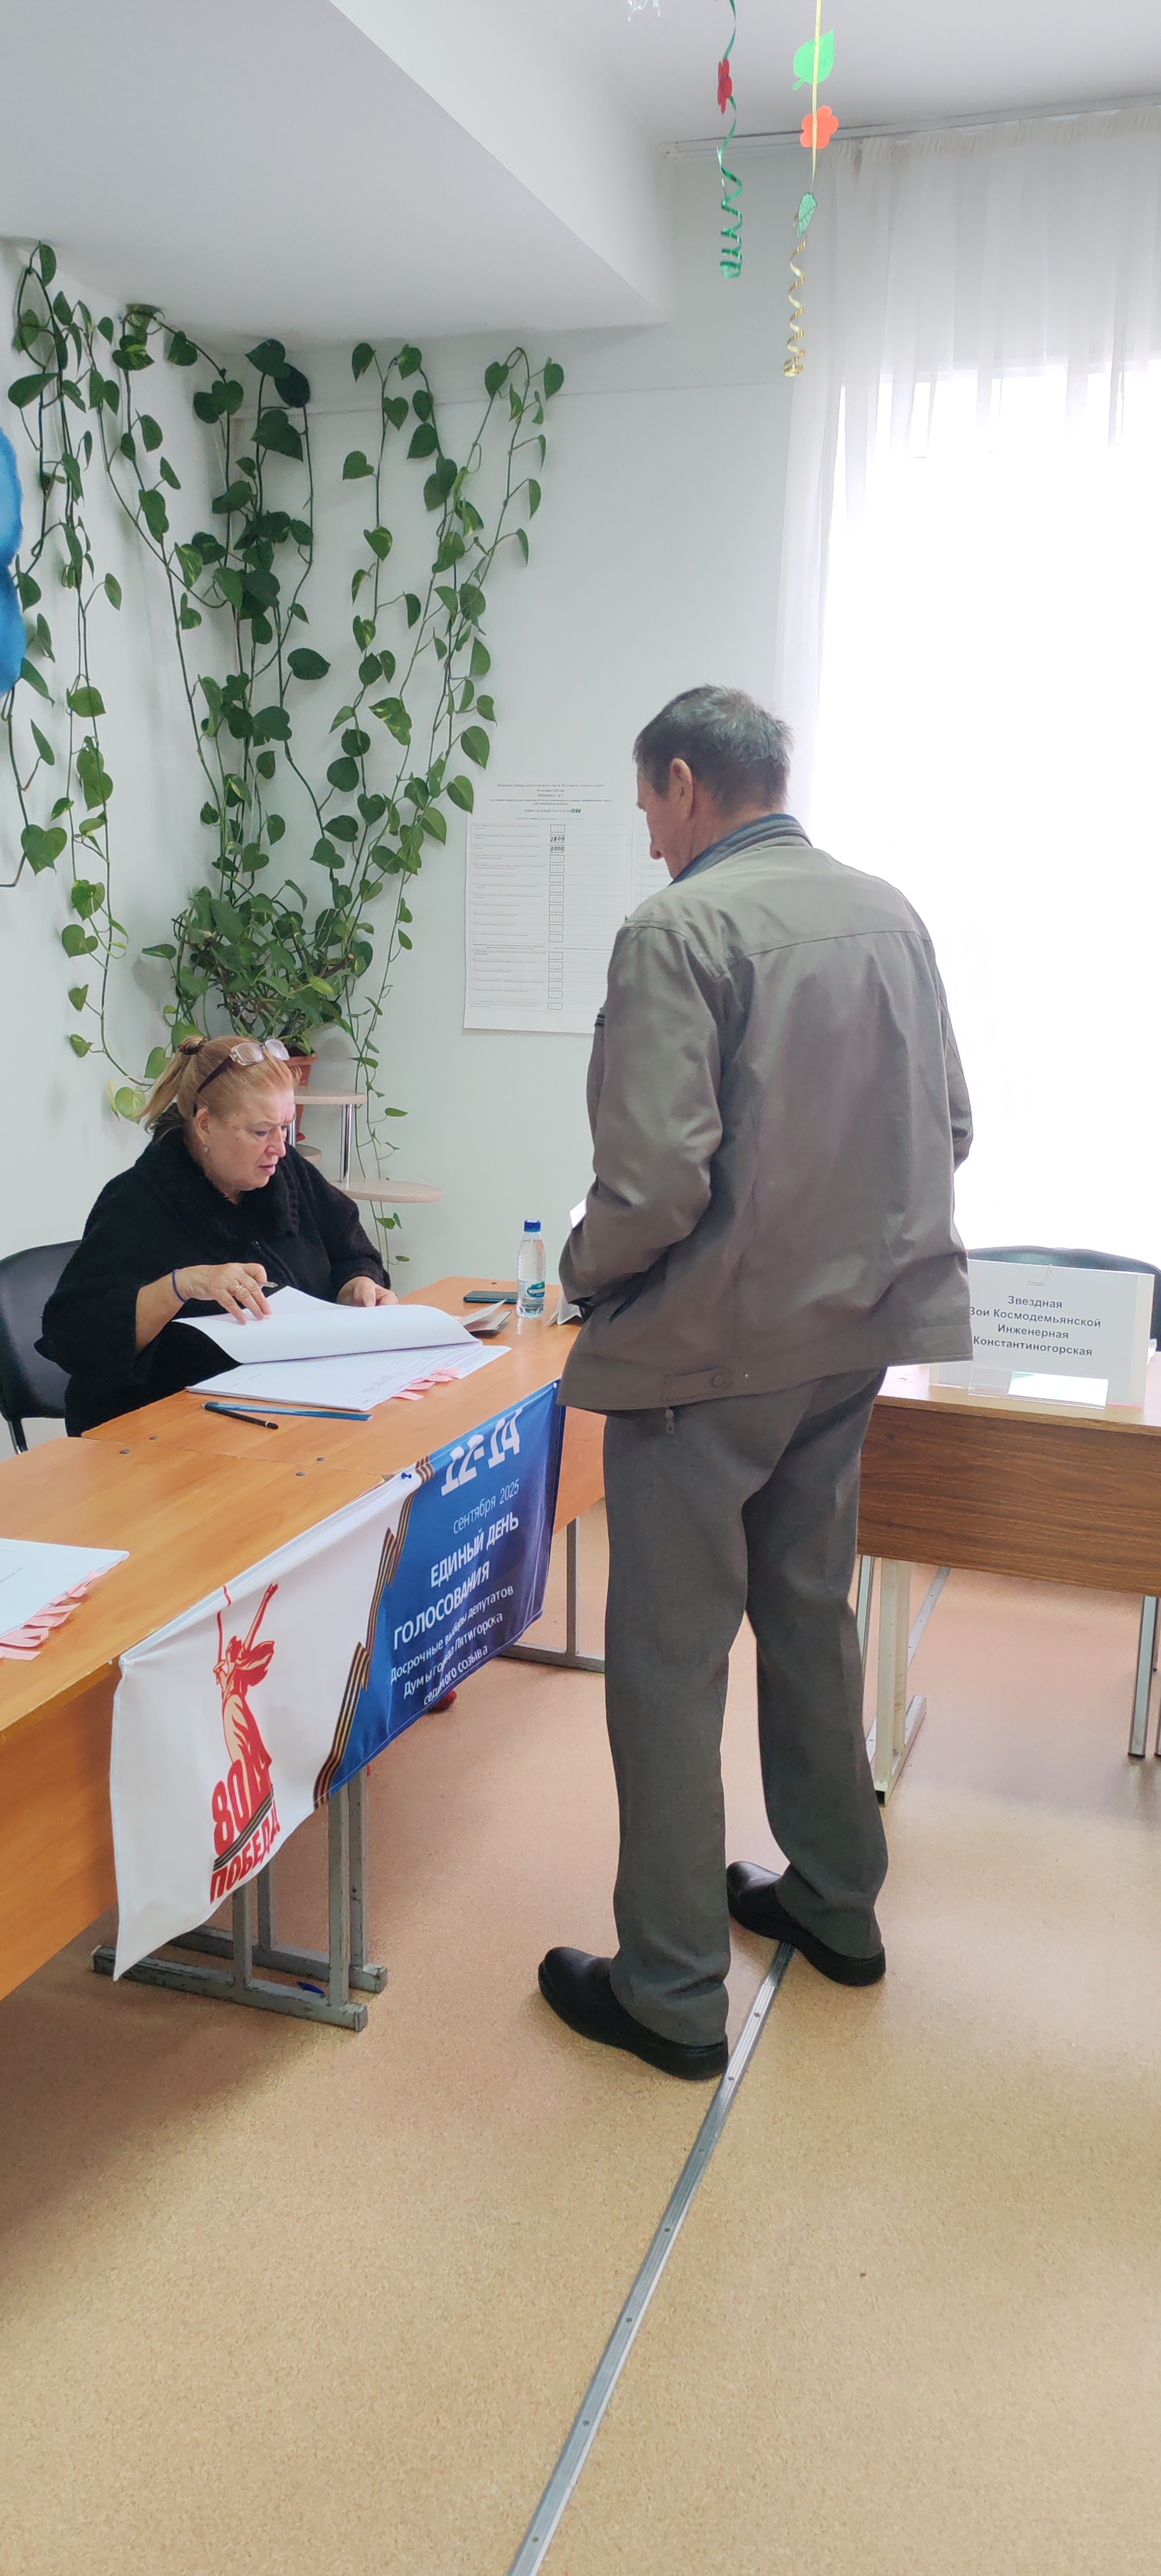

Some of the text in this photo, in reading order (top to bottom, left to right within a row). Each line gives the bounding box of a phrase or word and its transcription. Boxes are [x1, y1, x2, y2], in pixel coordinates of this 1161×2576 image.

[970, 1306, 1101, 1328] Зои Космодемьянской
[997, 1323, 1069, 1339] Инженерная
[1008, 1295, 1063, 1309] Звездная
[973, 1336, 1093, 1356] Константиногорская
[441, 1408, 523, 1496] 12-14
[453, 1478, 520, 1534] сентября 2025
[431, 1512, 519, 1588] ЕДИНЫЙ ДЕНЬ
[390, 1639, 444, 1686] Досрочные
[467, 1586, 514, 1621] депутатов
[394, 1561, 490, 1651] ГОЛОСОВАНИЯ
[404, 1670, 432, 1699] Думы
[455, 1613, 503, 1651] Пятигорска
[458, 1645, 488, 1673] созыва
[212, 1759, 252, 1857] 80
